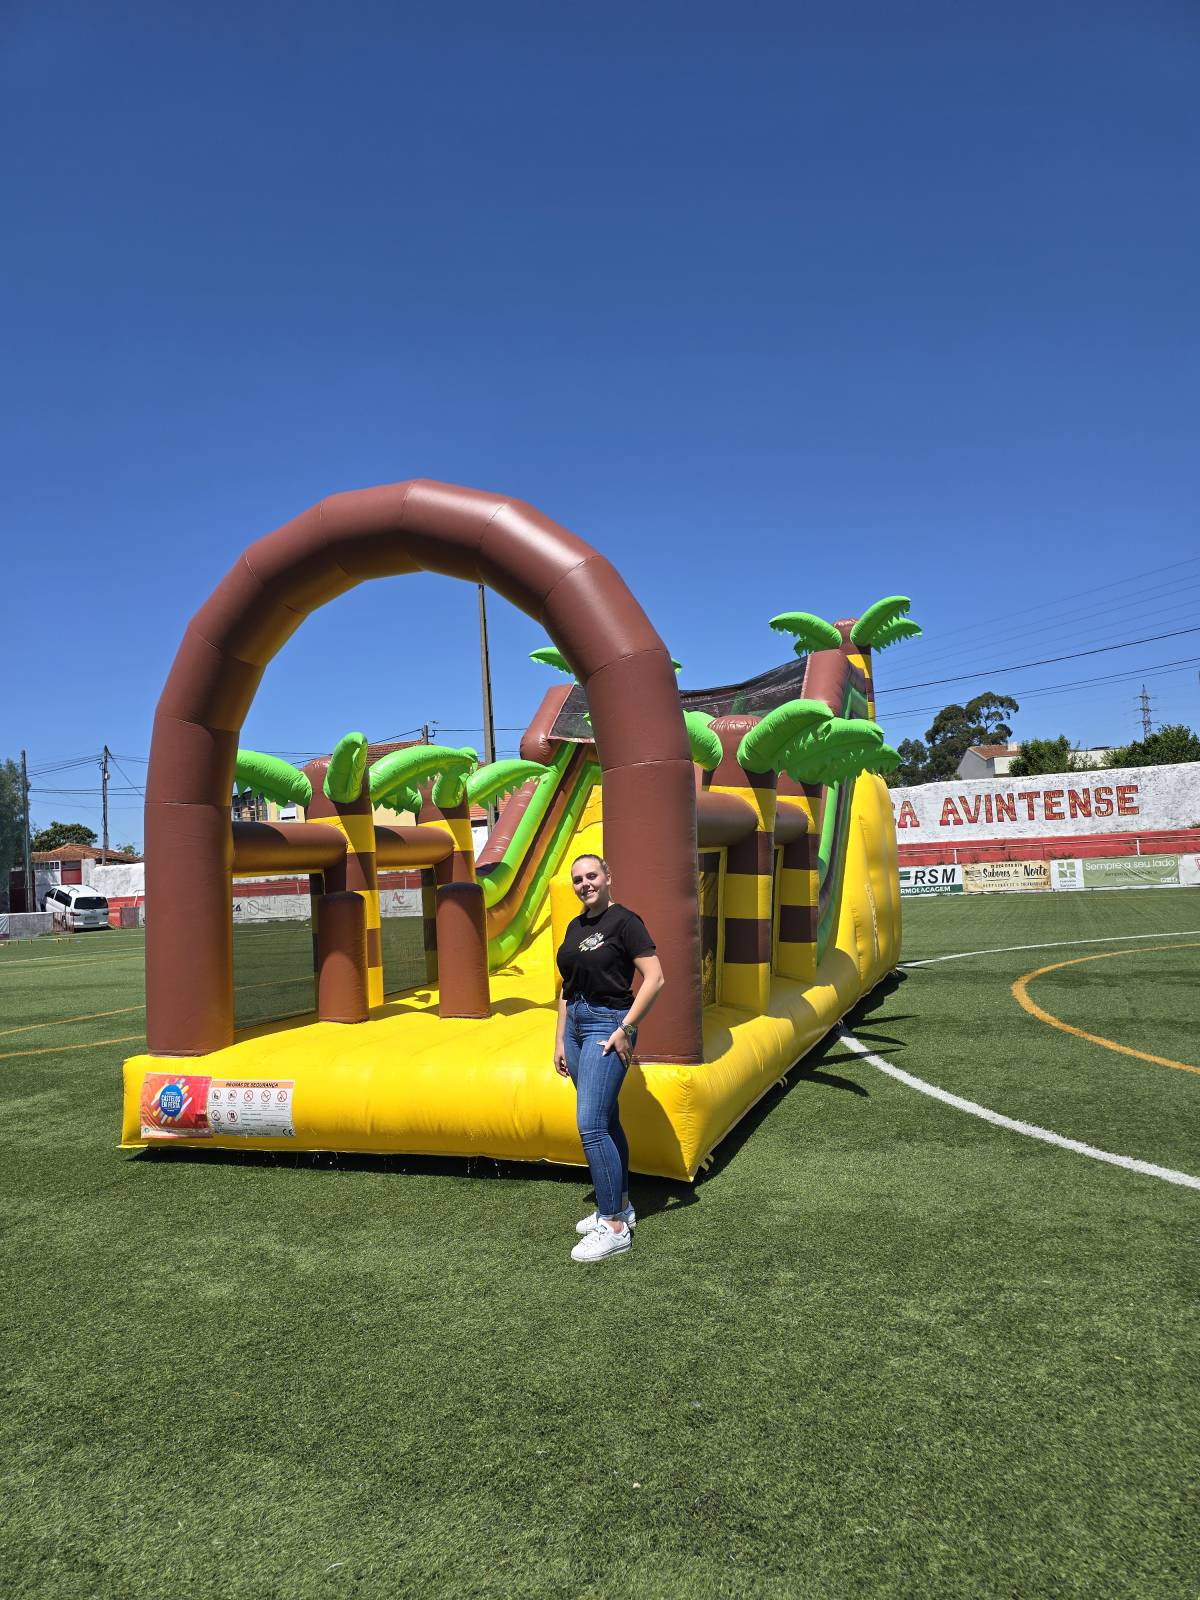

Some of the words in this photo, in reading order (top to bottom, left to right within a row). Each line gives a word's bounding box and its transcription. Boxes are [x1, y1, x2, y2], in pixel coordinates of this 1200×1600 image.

[939, 785, 1139, 826] AVINTENSE
[983, 868, 1011, 878] Sabores
[1024, 864, 1048, 876] Norte
[1085, 861, 1122, 871] Sempre
[1152, 859, 1175, 867] lado
[914, 868, 956, 885] RSM
